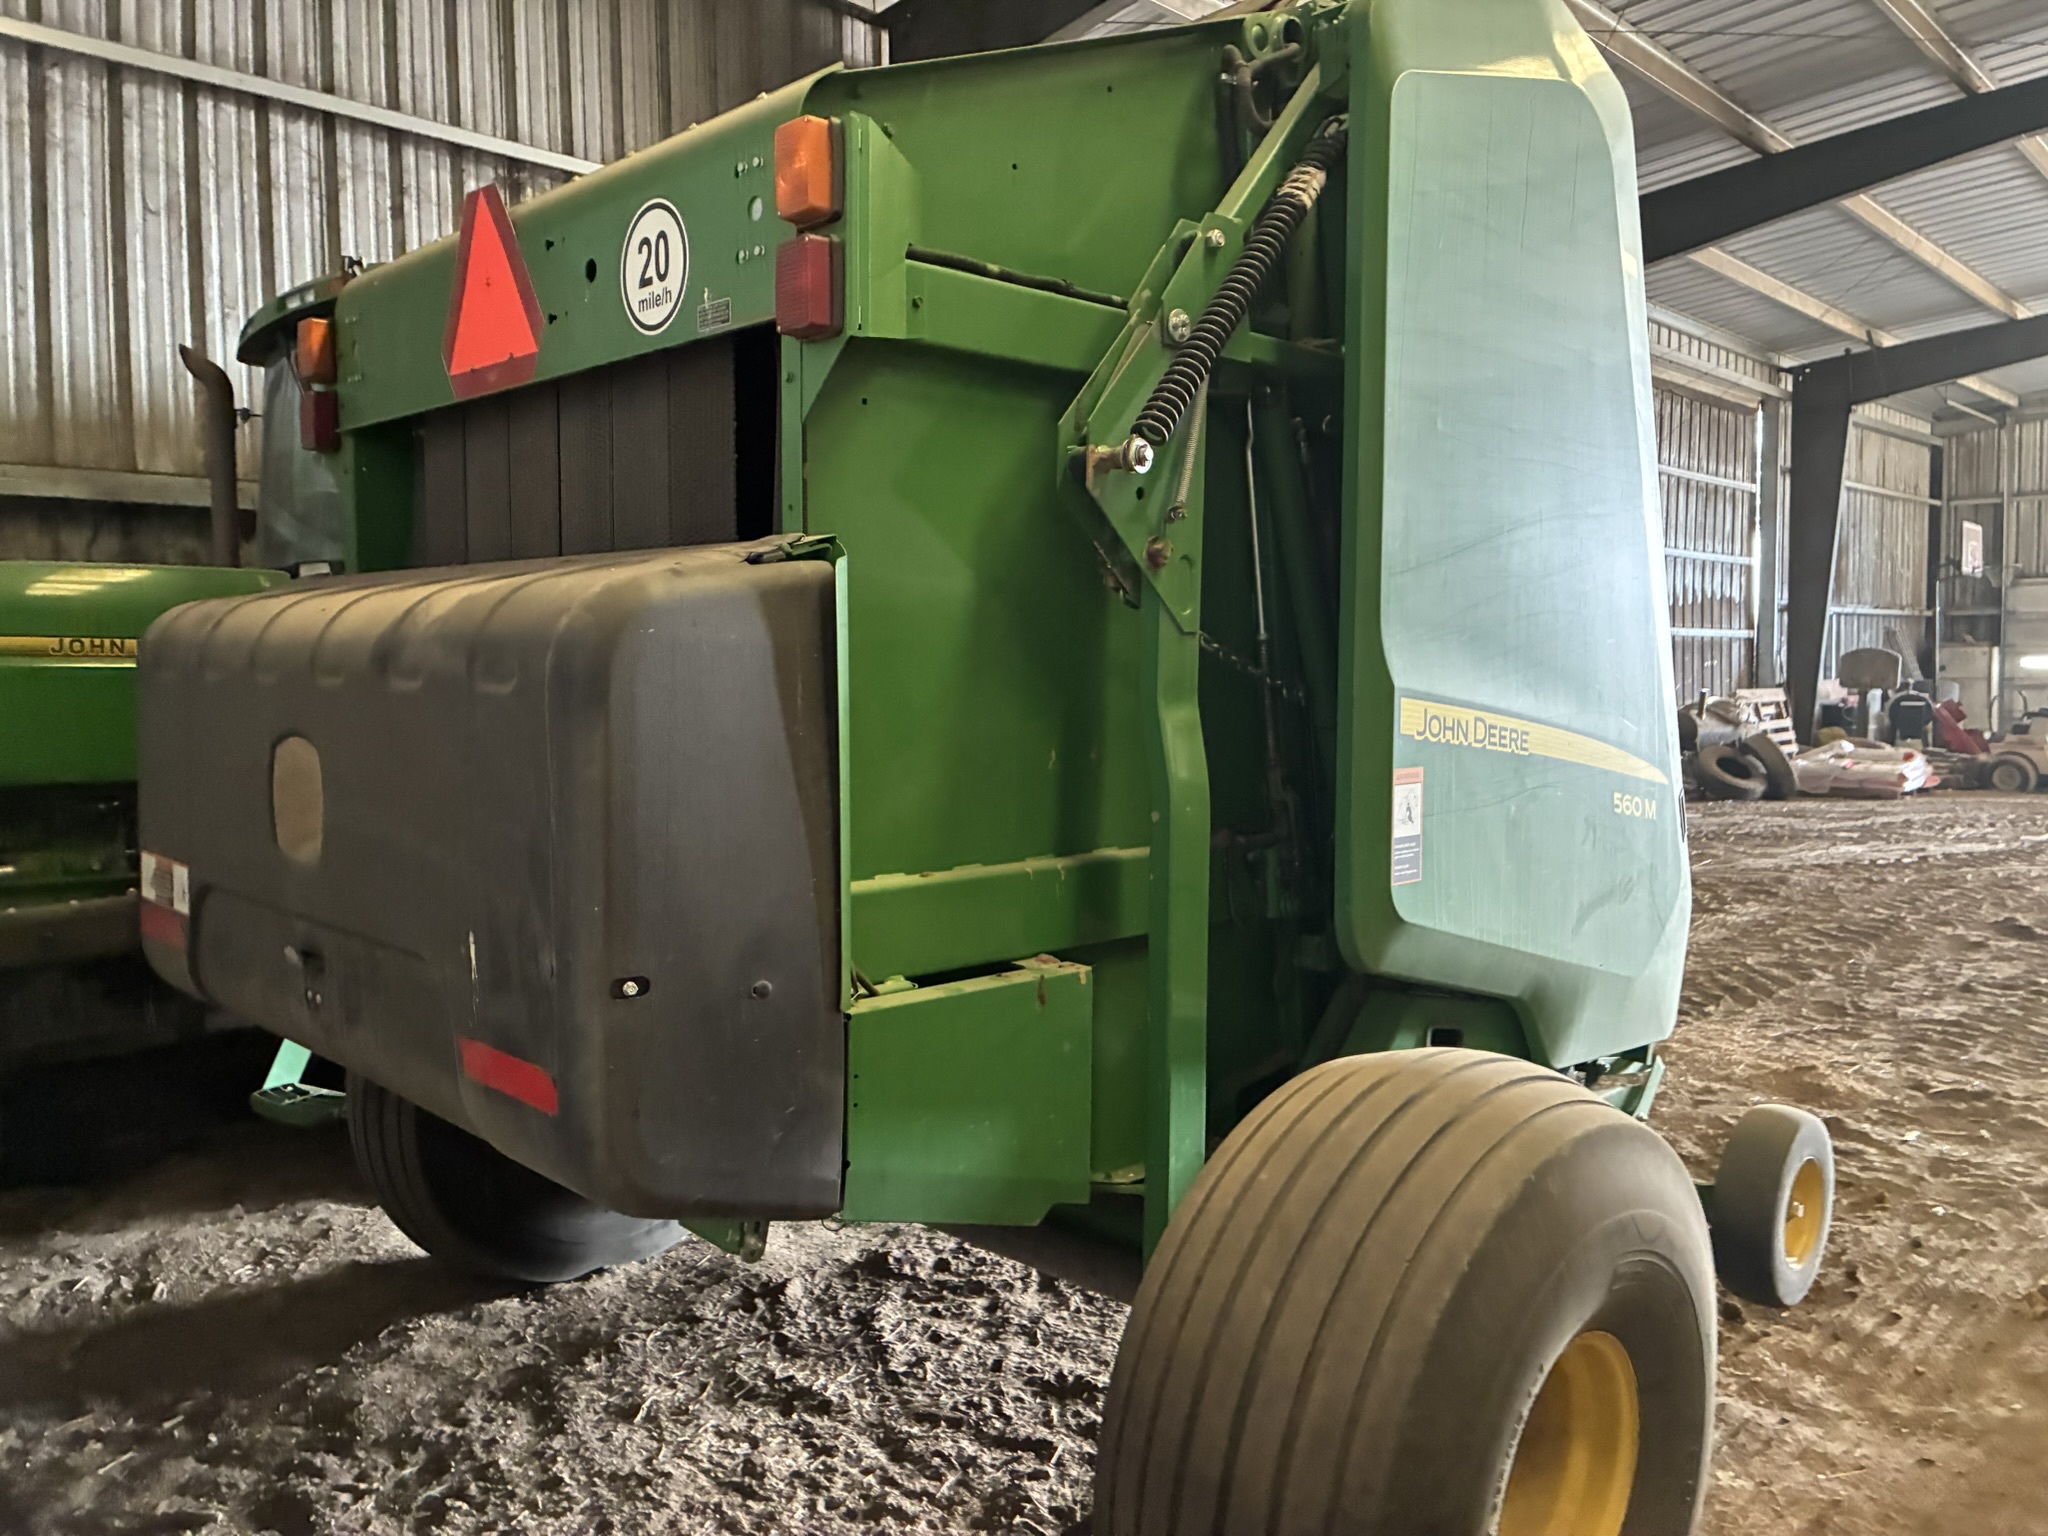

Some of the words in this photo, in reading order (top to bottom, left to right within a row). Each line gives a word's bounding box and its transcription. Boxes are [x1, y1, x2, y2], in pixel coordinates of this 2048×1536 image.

[638, 230, 669, 289] 20
[638, 287, 672, 313] mile/h
[50, 638, 125, 654] JOHN
